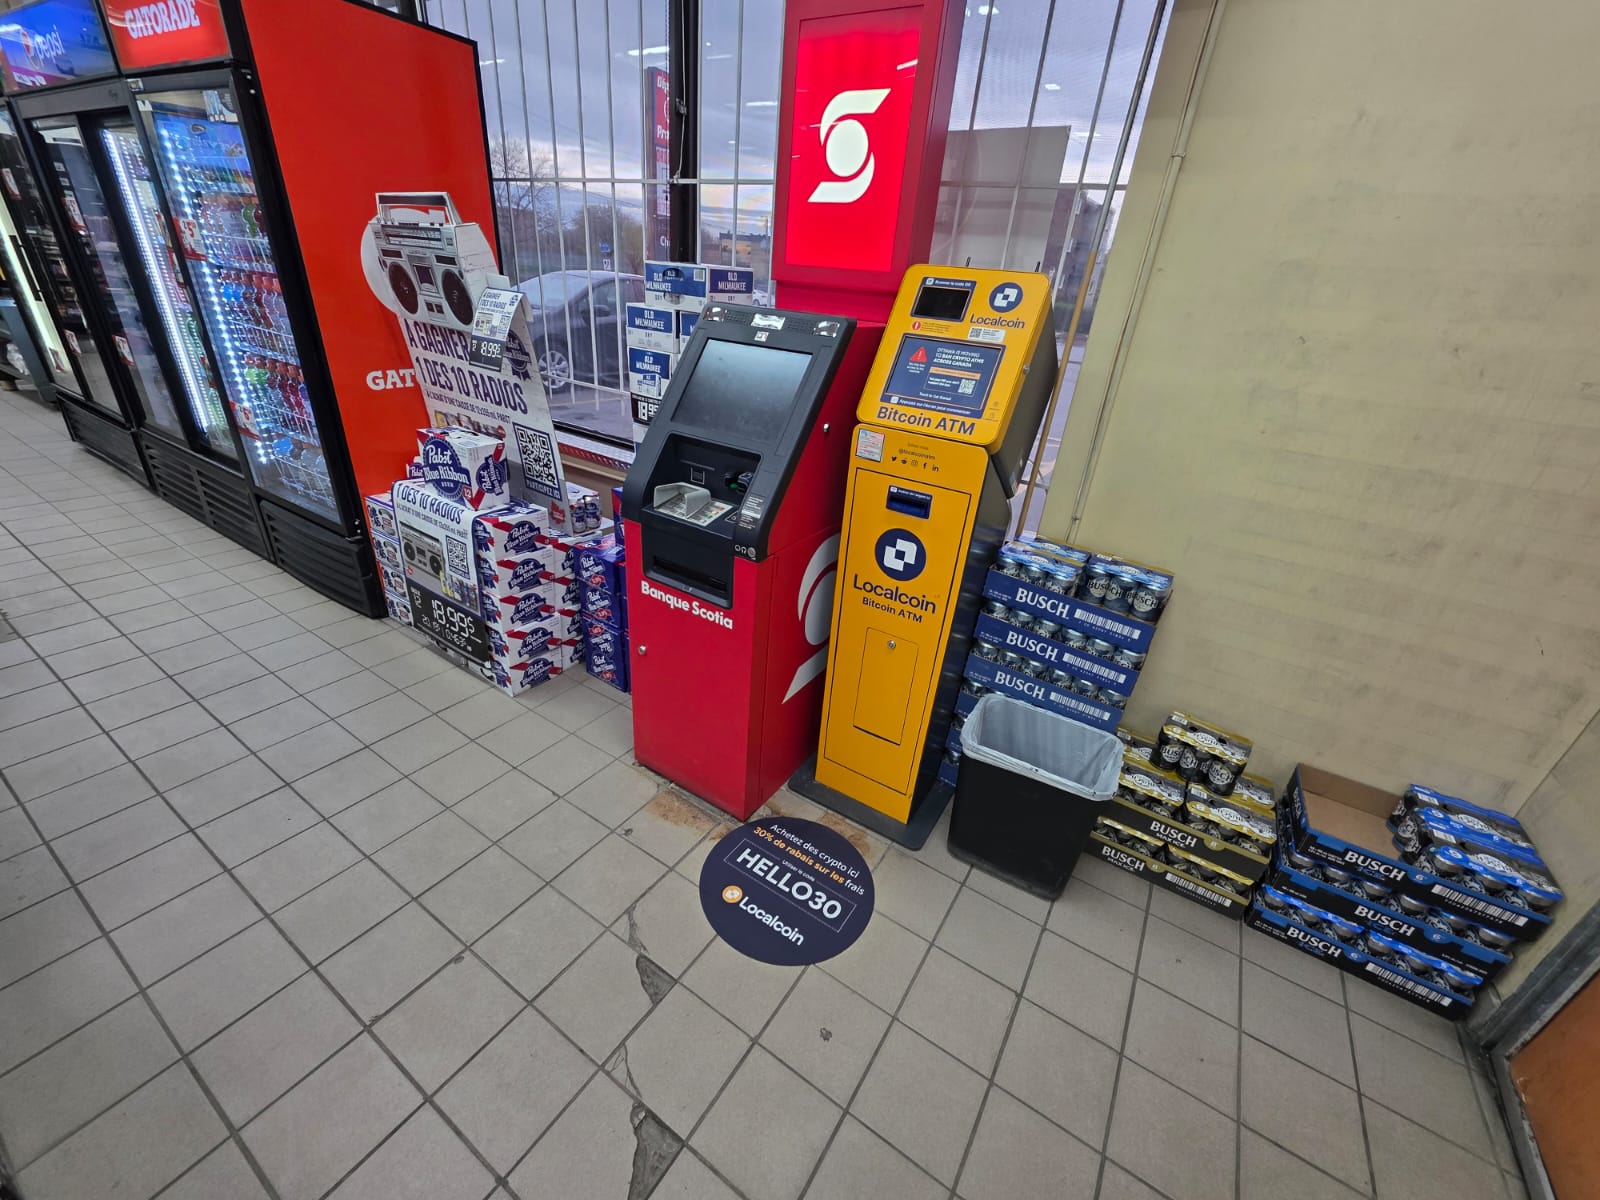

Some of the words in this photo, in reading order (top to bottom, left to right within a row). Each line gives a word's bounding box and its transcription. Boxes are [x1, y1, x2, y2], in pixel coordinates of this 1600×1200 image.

[124, 0, 200, 39] GATORADE
[33, 24, 65, 67] pepsi
[718, 280, 747, 291] MILWAUKEE
[728, 271, 738, 281] OLD
[635, 317, 665, 330] MILWAUKEE
[644, 310, 655, 319] OLD
[970, 314, 1026, 329] Localcoin
[413, 320, 470, 362] GAGNER
[636, 361, 661, 373] MILWAUKEE
[644, 355, 653, 364] OLD
[416, 356, 427, 384] 1
[423, 358, 454, 392] DES
[451, 366, 470, 397] 10
[468, 370, 528, 415] RADIOS
[877, 406, 932, 428] Bitcoin
[935, 416, 976, 436] ATM
[426, 444, 453, 465] Pabst
[423, 466, 440, 481] Blue
[440, 465, 470, 486] Ribbon
[402, 485, 420, 505] DES
[419, 493, 431, 510] 10
[430, 498, 465, 524] RADIOS
[463, 488, 472, 498] 12
[511, 524, 530, 538] Pabst
[516, 561, 534, 575] Pabst
[518, 596, 536, 611] Pabst
[640, 581, 691, 613] Banque
[691, 598, 734, 630] Scotia
[853, 573, 937, 614] Localcoin
[1015, 587, 1070, 620] BUSCH
[862, 597, 897, 615] Bitcoin
[897, 608, 924, 624] ATM
[526, 629, 543, 645] Pabst
[1006, 630, 1059, 662] BUSCH
[527, 660, 544, 676] Pabst
[994, 670, 1045, 701] BUSCH
[1150, 820, 1197, 847] BUSCH
[753, 826, 773, 842] 30%
[773, 837, 786, 849] de
[785, 842, 814, 866] rabais
[814, 861, 830, 875] sur
[829, 868, 845, 884] les
[844, 876, 865, 896] frais
[769, 824, 804, 846] Achetez
[803, 841, 819, 856] des
[819, 850, 847, 871] crypto
[847, 867, 860, 879] ici
[1102, 845, 1145, 871] BUSCH
[1345, 850, 1405, 881] BUSCH
[1357, 866, 1386, 881] ICE
[736, 847, 842, 919] HELLO30
[739, 896, 804, 946] Localcoin
[1354, 904, 1415, 937] BUSCH
[1287, 927, 1342, 958] BUSCH
